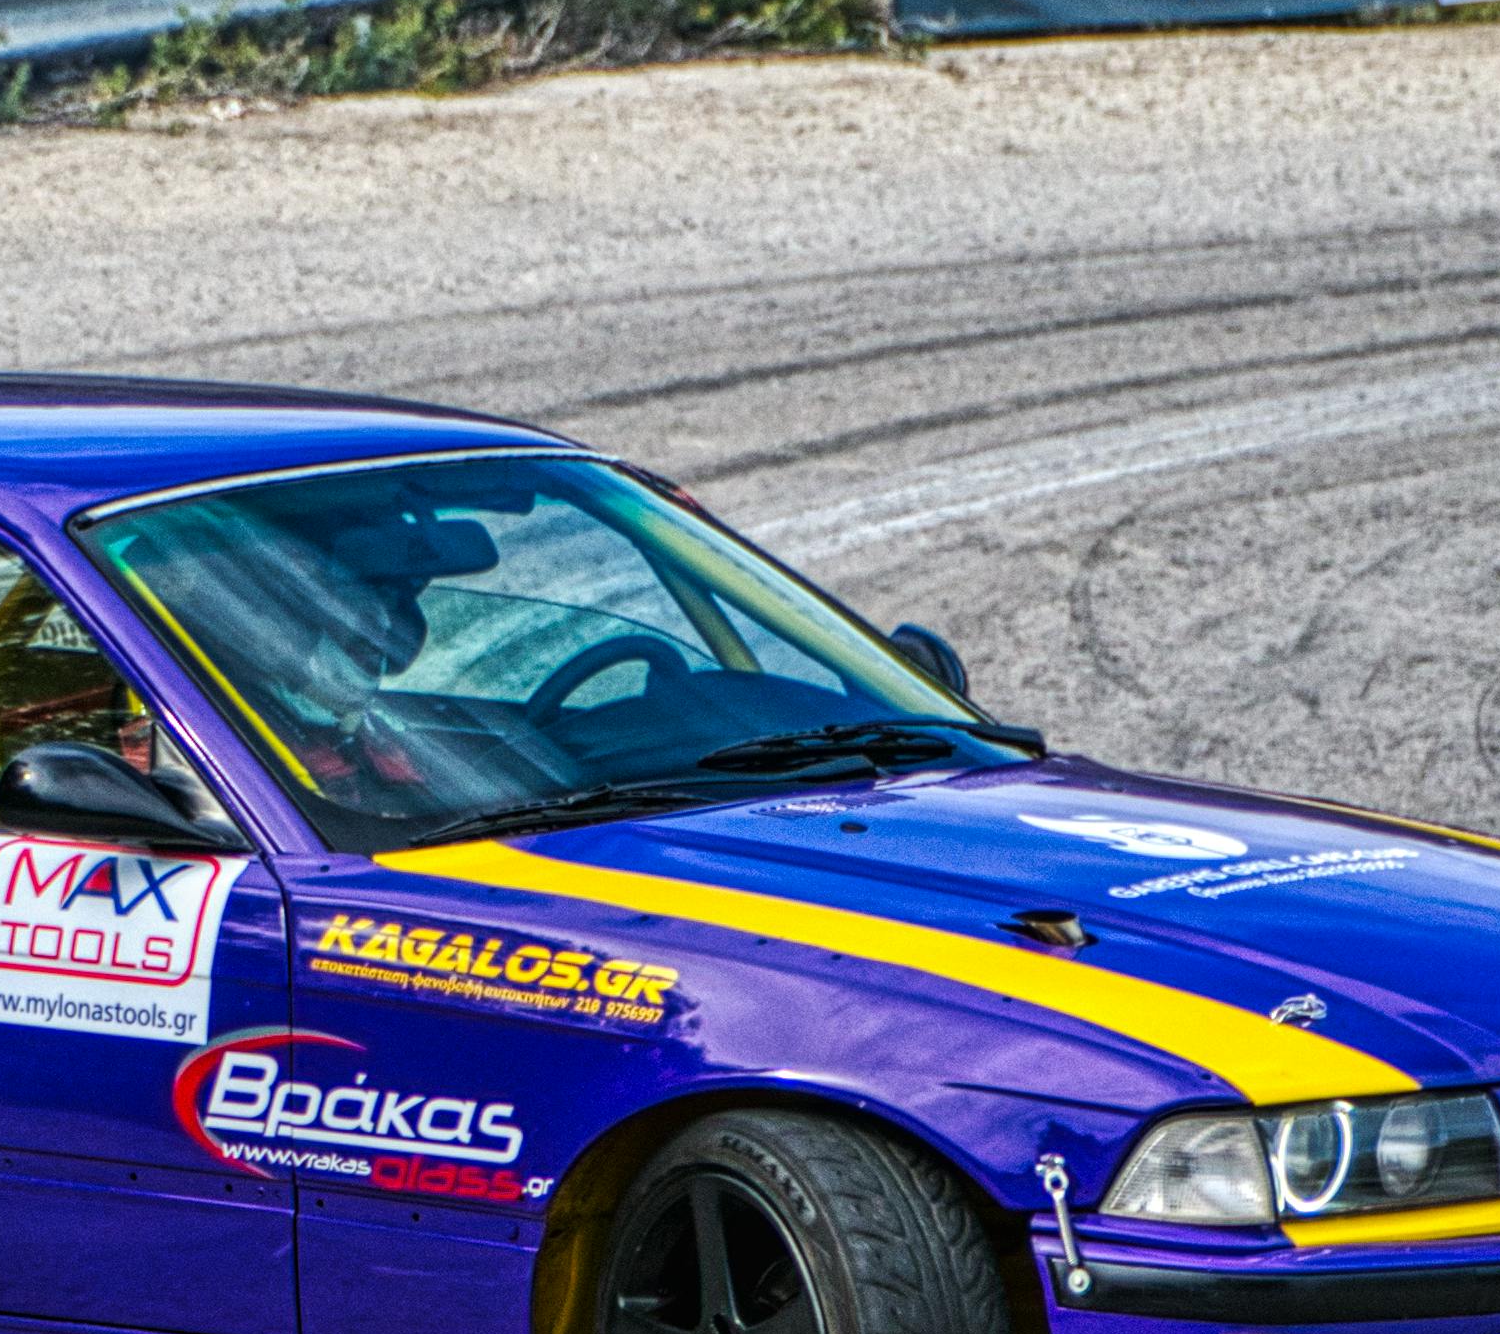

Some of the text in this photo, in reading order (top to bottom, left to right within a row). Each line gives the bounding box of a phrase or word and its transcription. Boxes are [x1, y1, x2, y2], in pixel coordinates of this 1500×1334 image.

[3, 848, 193, 922] MAX
[0, 920, 174, 974] TOOLS
[317, 913, 679, 1005] KAGALOS.GR
[605, 1001, 664, 1024] 9756997
